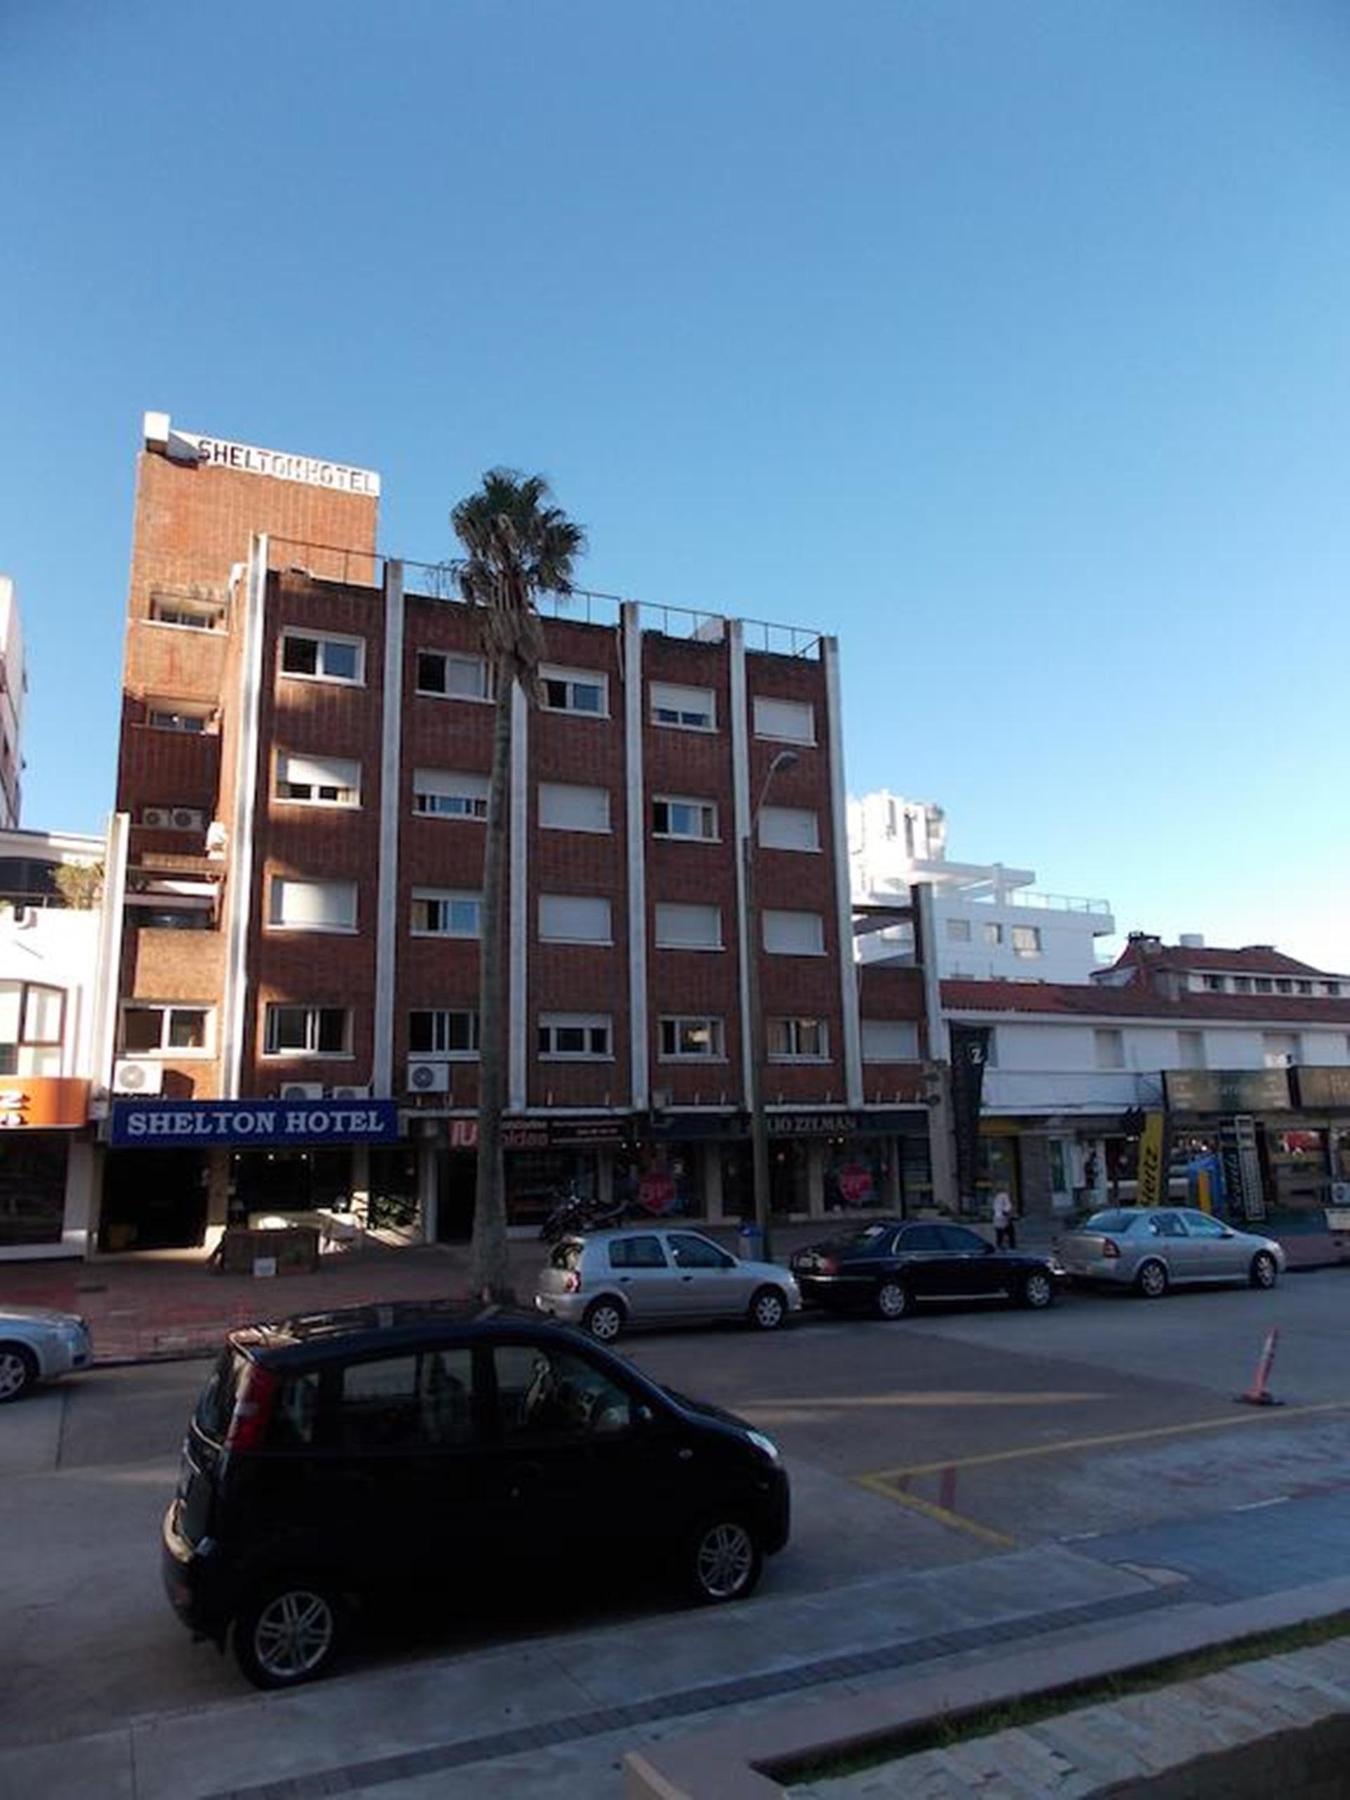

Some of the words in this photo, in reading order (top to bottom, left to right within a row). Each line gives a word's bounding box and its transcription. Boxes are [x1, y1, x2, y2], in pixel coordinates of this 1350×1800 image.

[199, 440, 302, 477] SHELTON
[304, 459, 377, 493] HOTEL
[127, 1111, 275, 1136] SHELTON
[285, 1110, 385, 1133] HOTEL
